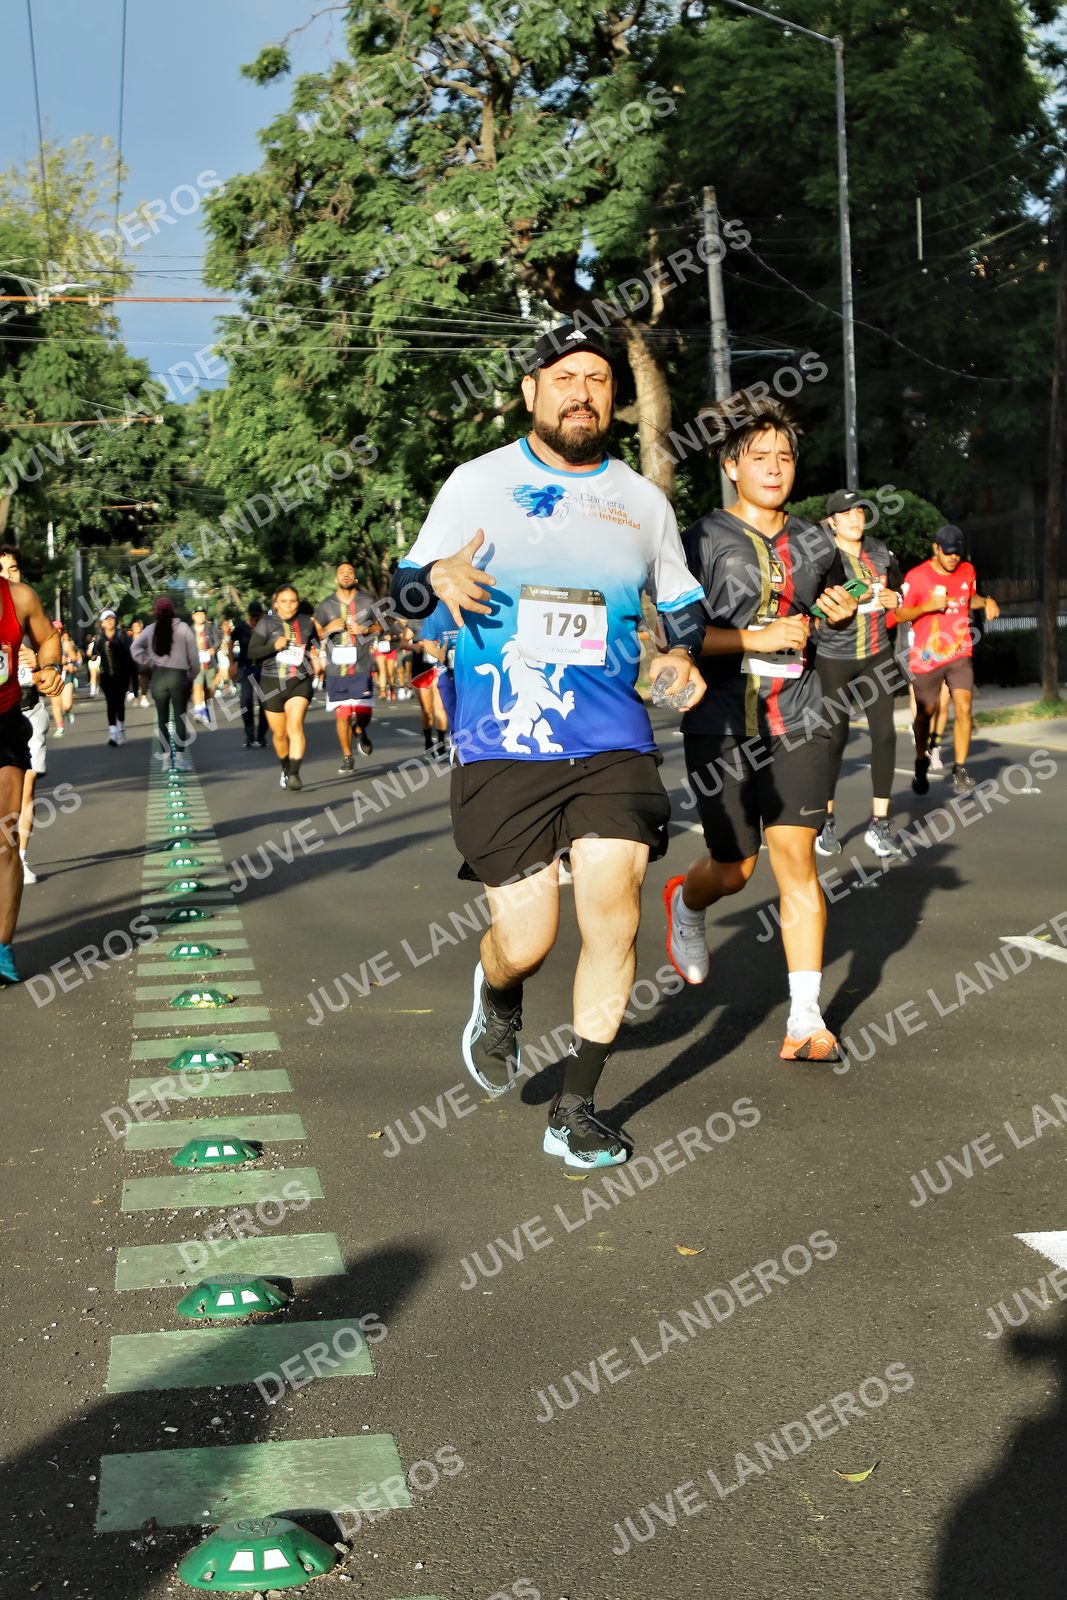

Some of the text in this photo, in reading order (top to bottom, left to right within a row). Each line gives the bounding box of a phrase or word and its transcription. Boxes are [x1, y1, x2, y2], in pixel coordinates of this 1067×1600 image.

[581, 493, 625, 510] Carrera
[607, 506, 628, 518] Vida
[599, 512, 641, 530] Integridad
[543, 612, 587, 637] 179
